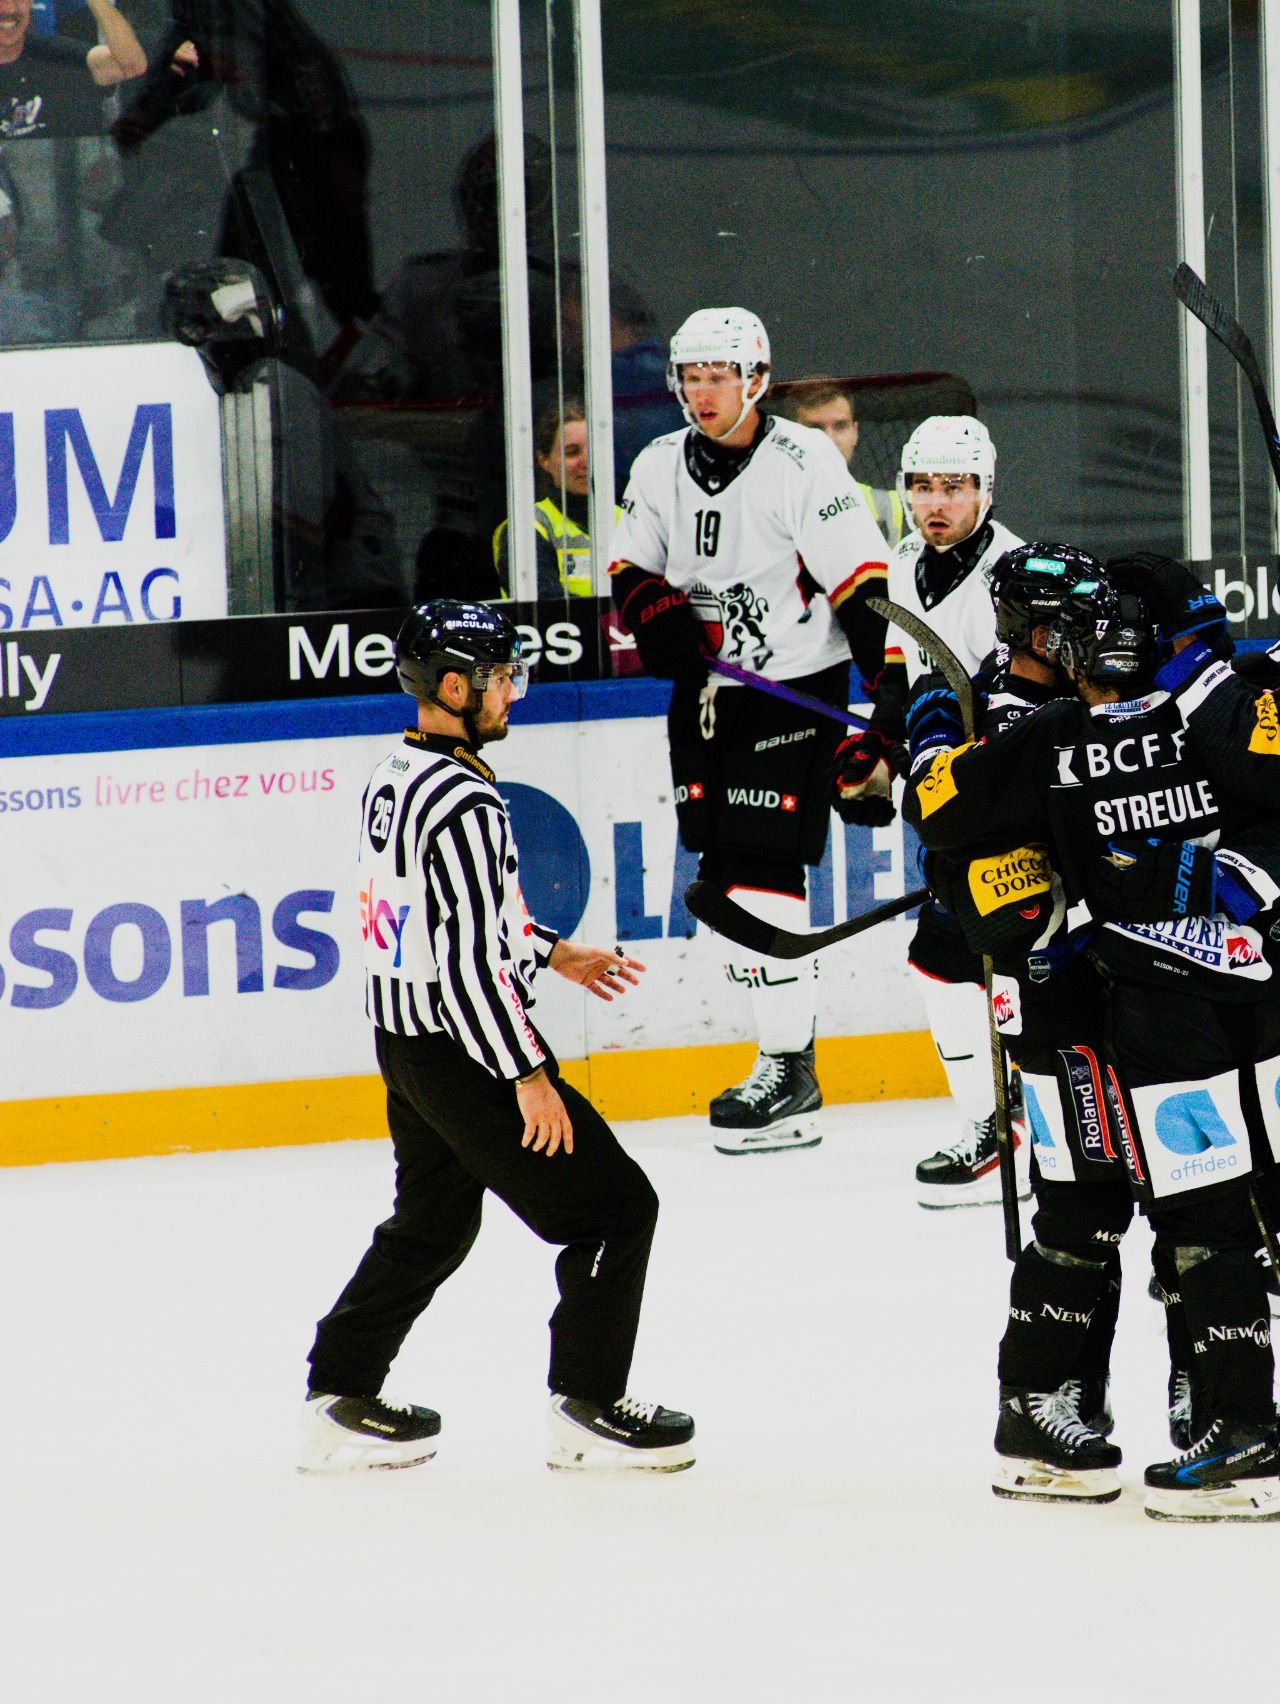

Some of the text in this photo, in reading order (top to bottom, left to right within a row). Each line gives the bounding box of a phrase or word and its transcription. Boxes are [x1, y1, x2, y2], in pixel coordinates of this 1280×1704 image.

[0, 402, 177, 547] M
[919, 453, 968, 466] vaudoise
[694, 508, 722, 558] 19
[445, 620, 495, 631] CIRCULAR
[462, 612, 478, 621] GO
[288, 620, 584, 682] Mees
[0, 640, 62, 712] ly
[754, 727, 817, 752] BAUER
[95, 774, 165, 807] livre
[175, 769, 250, 801] chez
[260, 768, 336, 796] vous
[727, 787, 781, 809] VAUD
[1094, 779, 1220, 837] STREULE
[370, 796, 394, 841] 26
[1172, 840, 1196, 914] BAUER
[0, 888, 341, 1010] sons
[1074, 1083, 1102, 1149] Roland
[1170, 1153, 1238, 1181] affidea
[1225, 1441, 1267, 1466] BAUER
